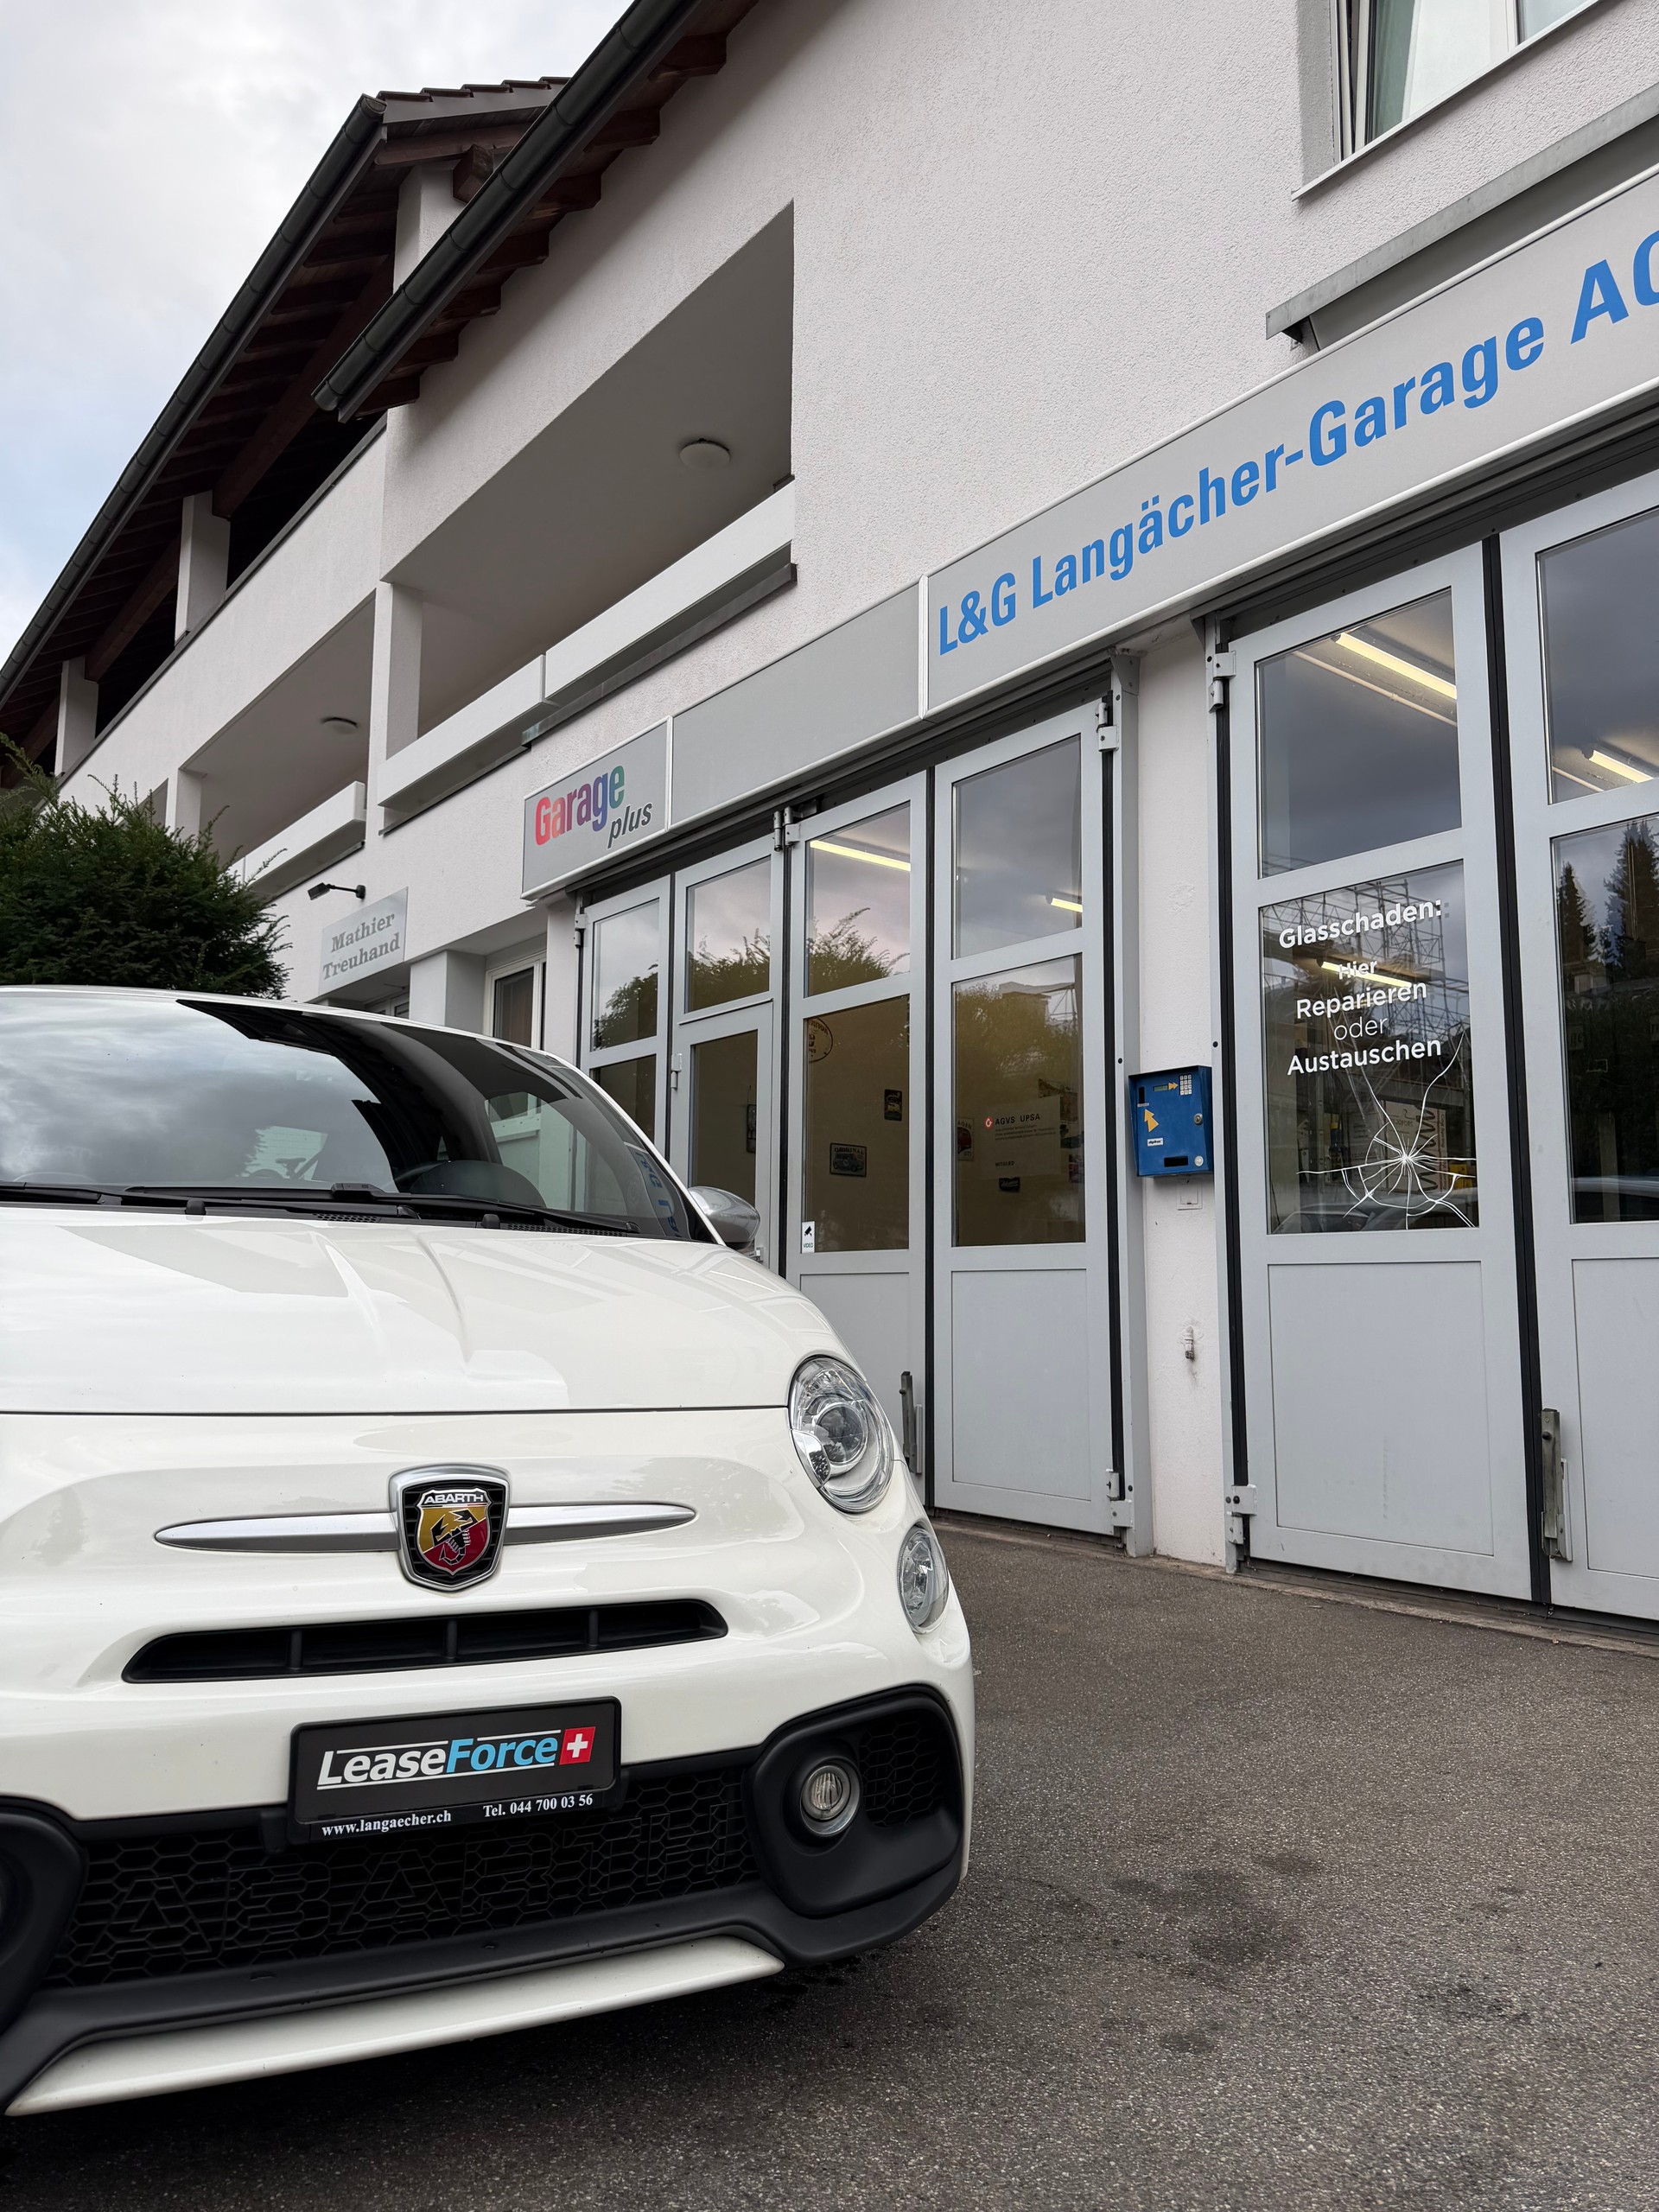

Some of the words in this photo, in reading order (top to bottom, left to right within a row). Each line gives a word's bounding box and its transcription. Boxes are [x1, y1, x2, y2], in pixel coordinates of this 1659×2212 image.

[938, 572, 1016, 656] L&G
[1032, 316, 1544, 610] Langächer-Garage
[536, 766, 625, 844] Garage
[607, 803, 652, 849] plus
[331, 911, 396, 953] Mathier
[1279, 898, 1442, 949] Glasschaden:
[322, 933, 401, 981] Treuhand
[1338, 958, 1378, 980] Hier
[1296, 982, 1427, 1020] Reparieren
[1333, 1017, 1388, 1041] oder
[1287, 1039, 1442, 1076] Austauschen
[995, 1116, 1015, 1126] AGVS
[1020, 1113, 1041, 1123] UPSA
[423, 1492, 484, 1504] ABARTH
[316, 1737, 559, 1786] LeaseForce
[321, 1809, 452, 1837] www.langaecher.ch
[483, 1803, 506, 1818] Tel.
[510, 1800, 532, 1815] 044
[535, 1797, 557, 1812] 700
[561, 1796, 575, 1809] 03
[578, 1793, 594, 1808] 56
